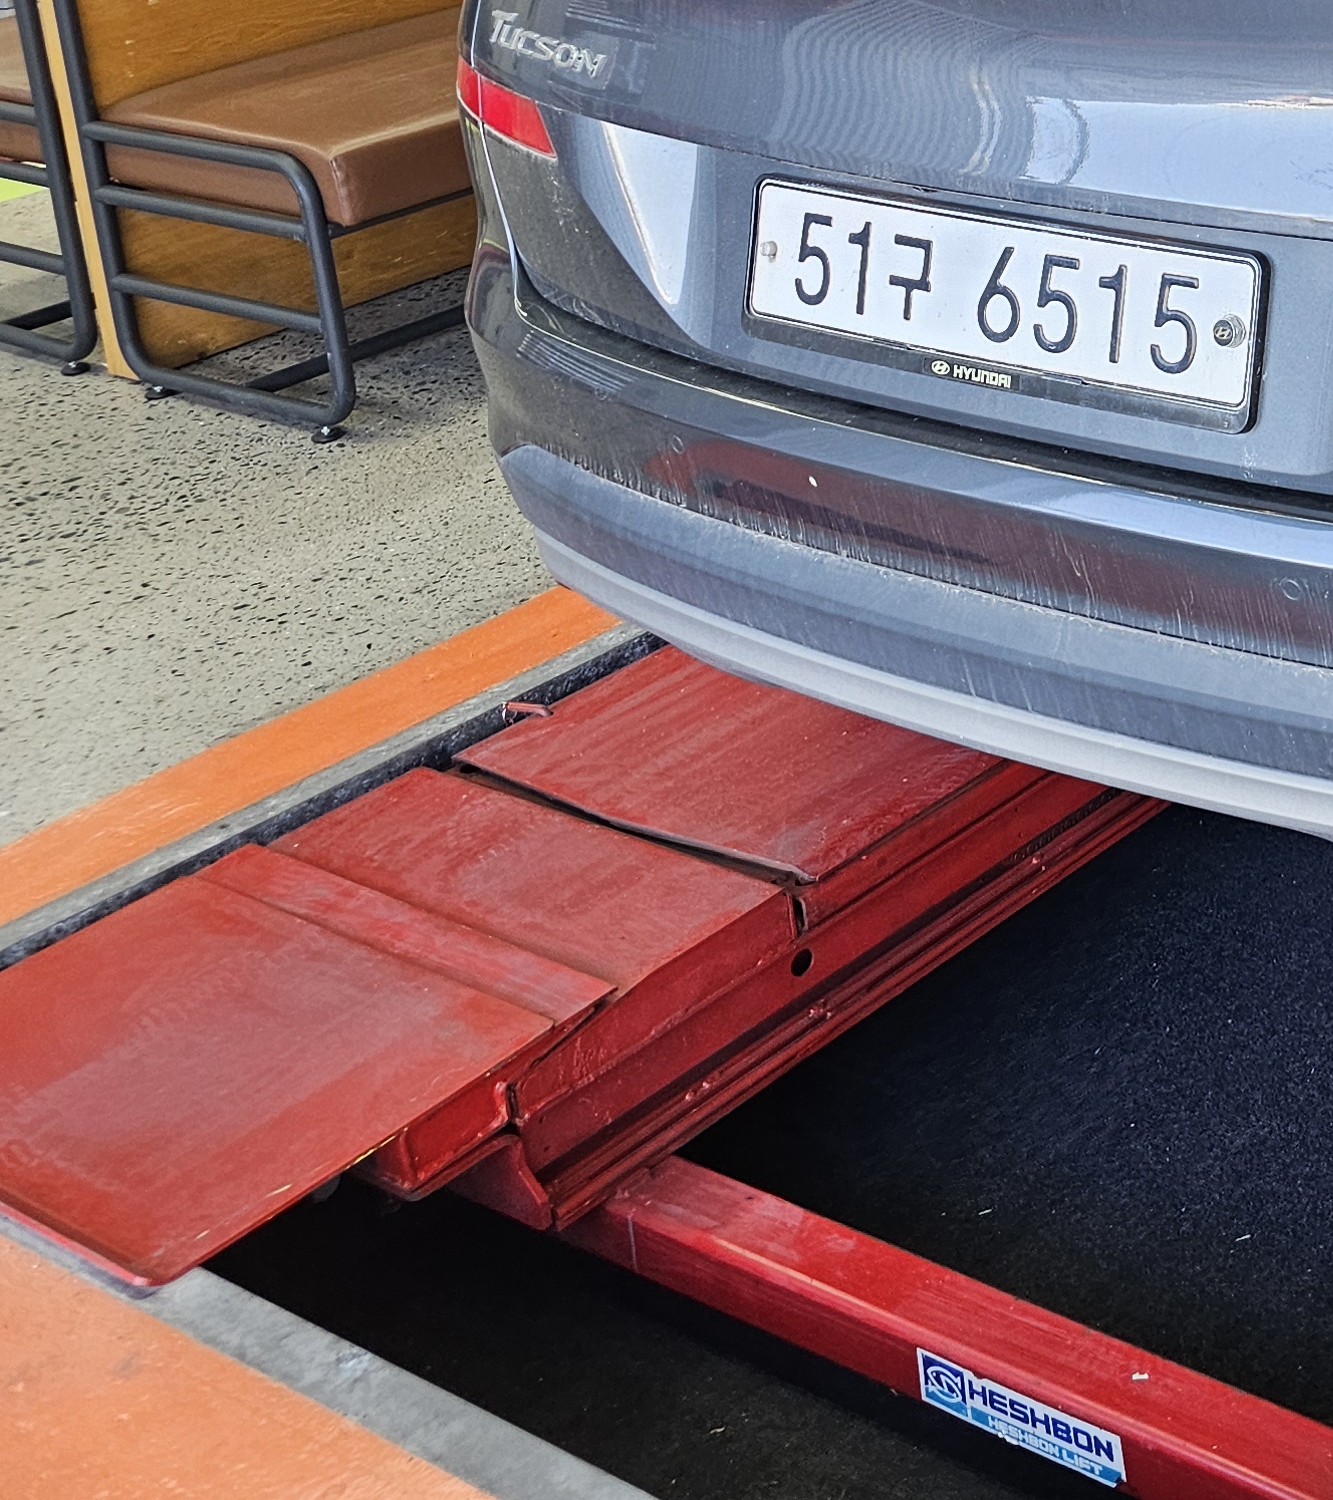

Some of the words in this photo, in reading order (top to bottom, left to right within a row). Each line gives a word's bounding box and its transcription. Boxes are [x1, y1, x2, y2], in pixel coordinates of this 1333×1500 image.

[794, 211, 934, 322] 51구
[976, 246, 1200, 374] 6515
[953, 364, 1012, 389] HYUNDAI
[968, 1379, 1115, 1463] HESHBON
[987, 1415, 1060, 1458] HESHBON
[1061, 1448, 1104, 1476] LIFT
